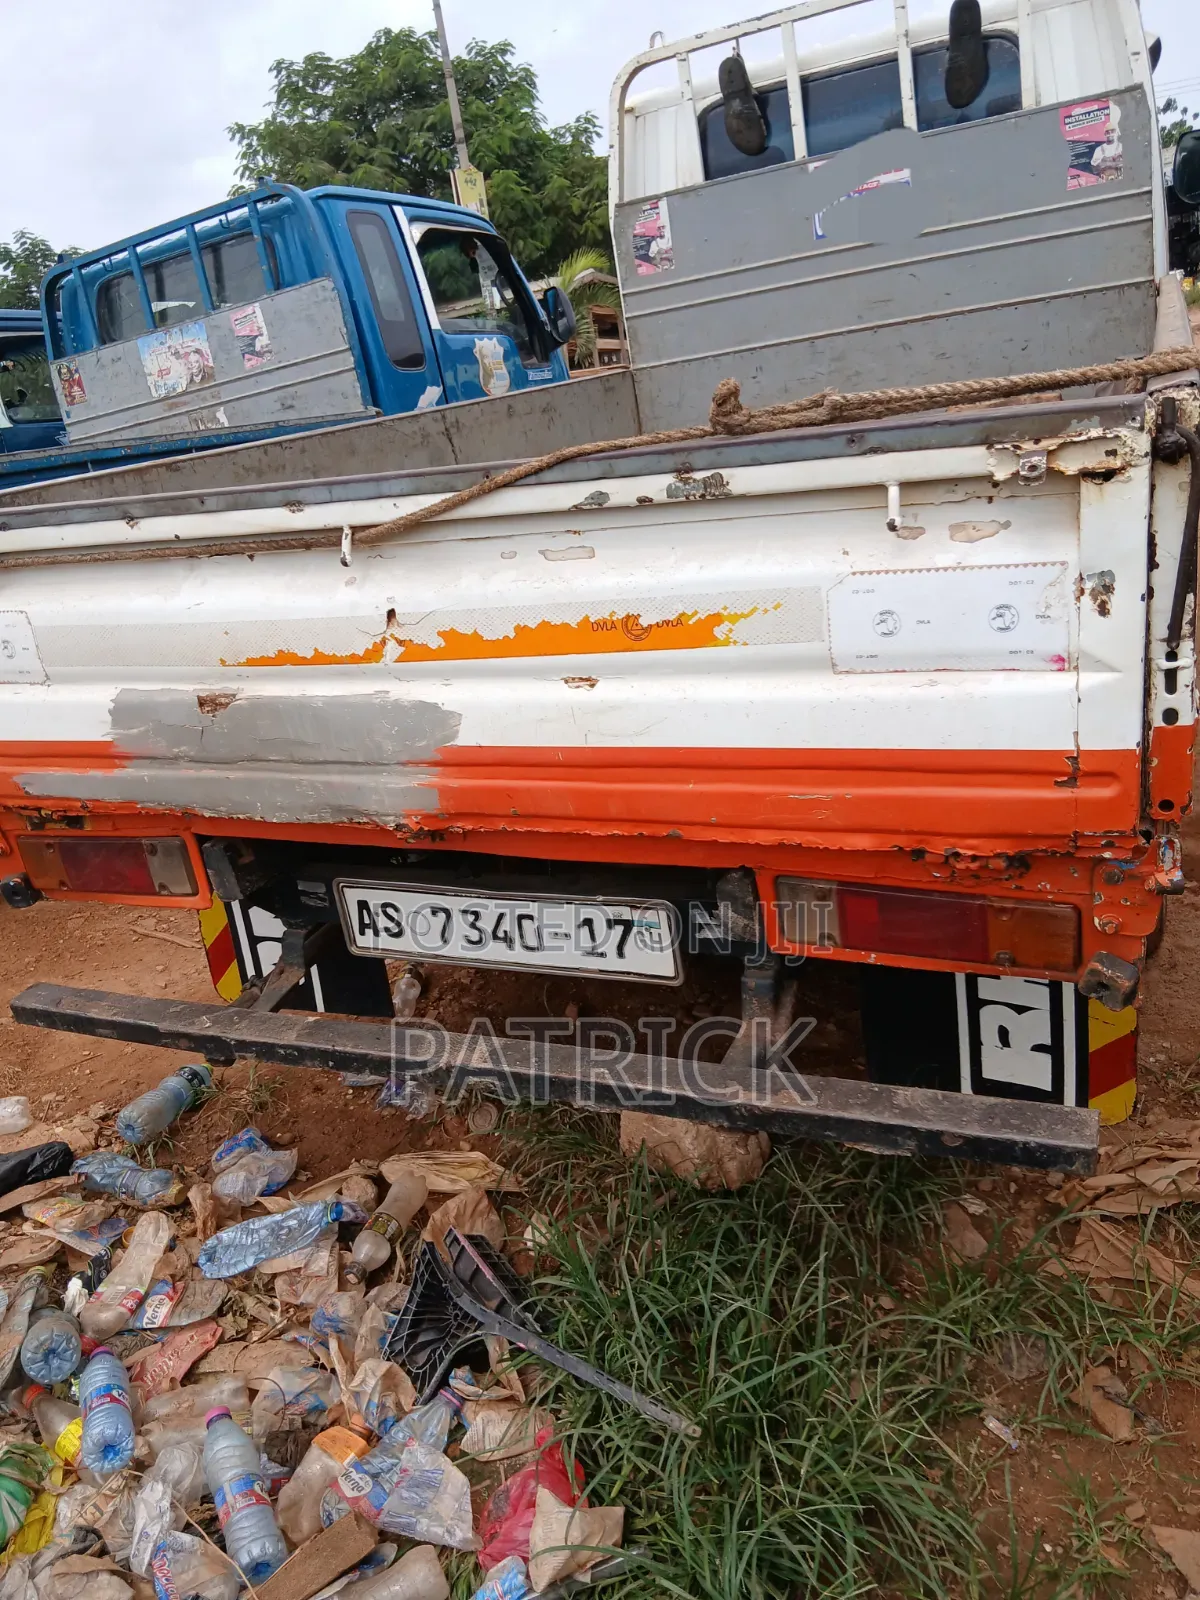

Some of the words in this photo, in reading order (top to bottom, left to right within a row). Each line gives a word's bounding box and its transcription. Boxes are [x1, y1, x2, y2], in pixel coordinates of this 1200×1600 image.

[1064, 109, 1109, 123] INSTALLATION
[591, 620, 617, 632] DVLA
[656, 617, 684, 629] DVLA
[356, 899, 406, 940] AS
[143, 1296, 167, 1328] Verna
[340, 1469, 366, 1494] Verna
